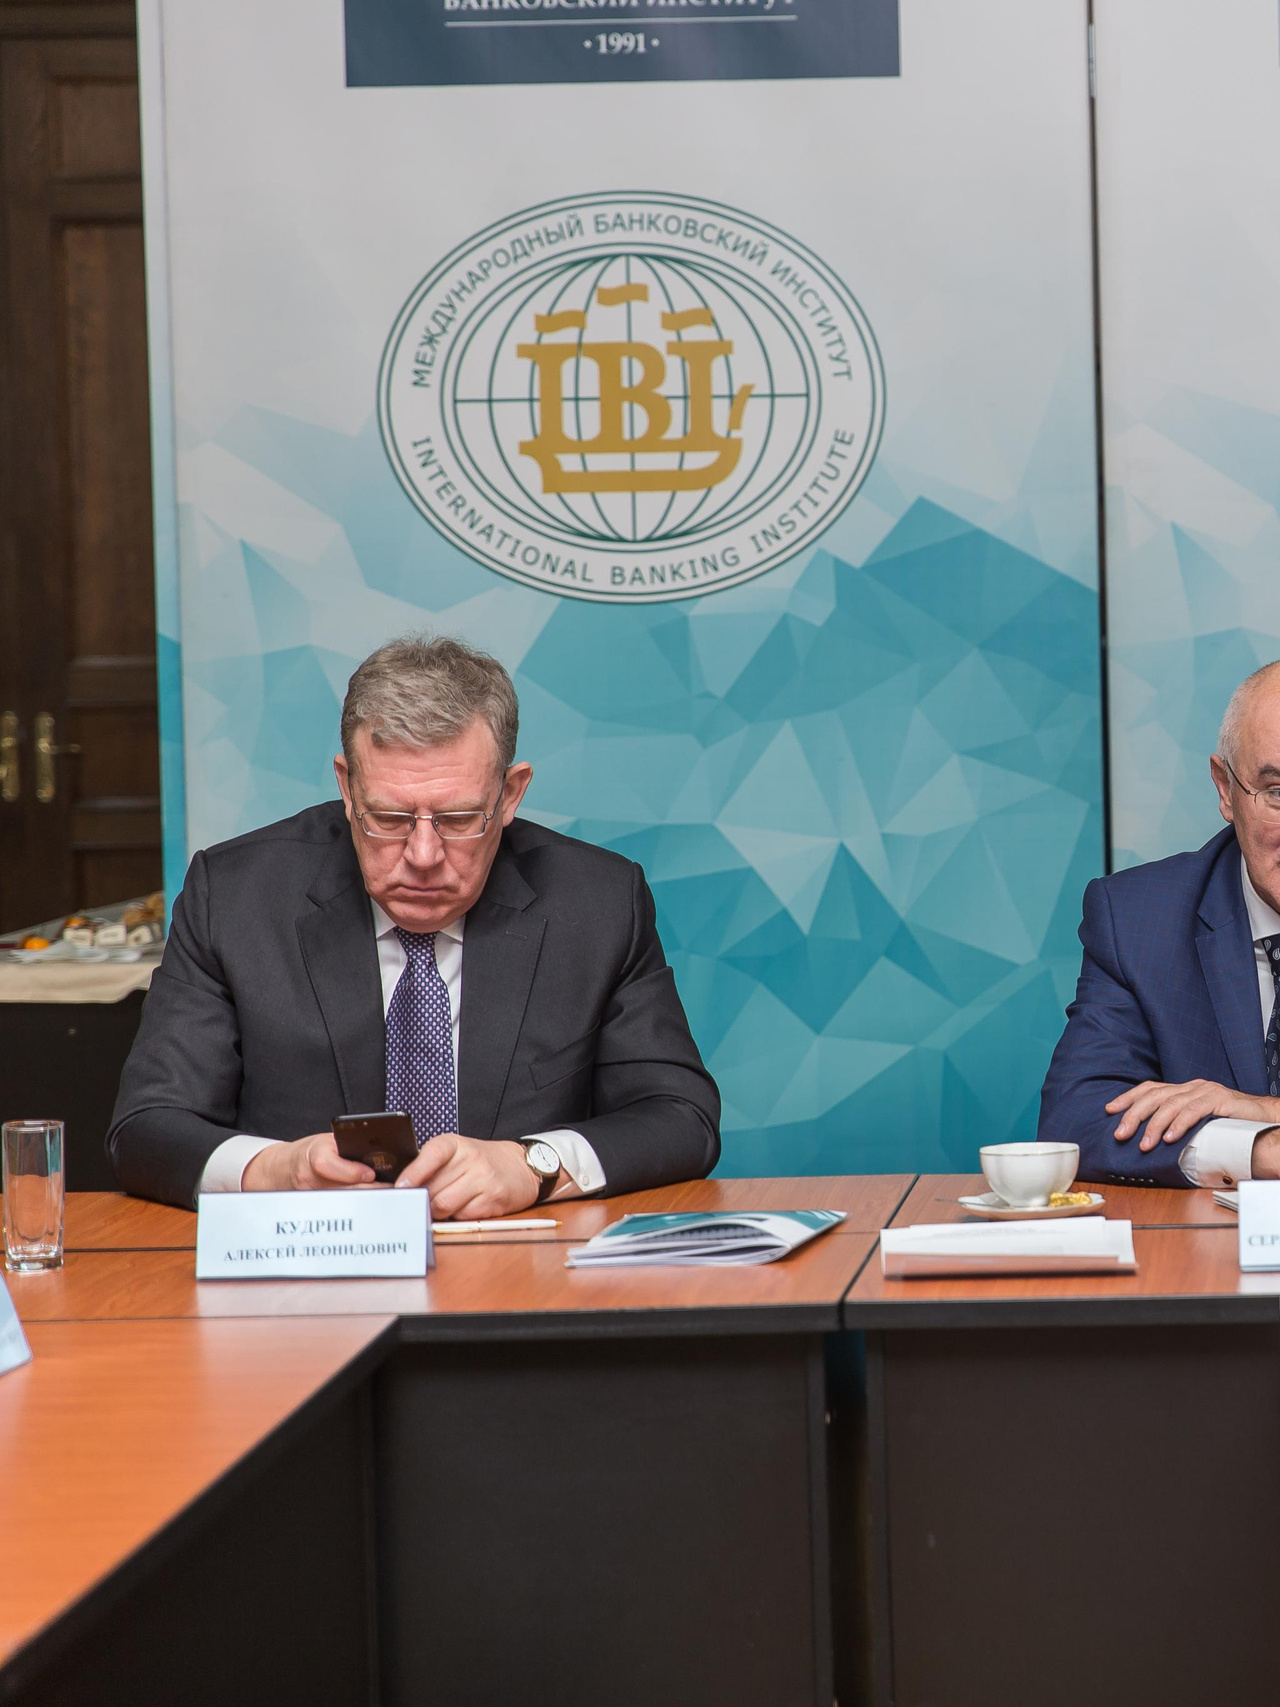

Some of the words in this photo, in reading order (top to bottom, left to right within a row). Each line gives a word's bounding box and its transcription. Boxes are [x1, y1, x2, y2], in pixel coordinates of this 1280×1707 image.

[595, 32, 647, 54] 1991
[411, 213, 585, 388] МЕЖДУНАРОДНЫЙ
[593, 212, 770, 267] БАНКОВСКИЙ
[771, 259, 853, 382] ИНСТИТУТ
[411, 436, 594, 584] INTERNATIONAL
[611, 547, 741, 586] BANKING
[749, 428, 855, 554] INSTITUTE
[275, 1218, 353, 1235] КУДРИН
[223, 1244, 296, 1261] АЛЕКСЕЙ
[300, 1242, 408, 1257] ЛЕОНИДОВИЧ
